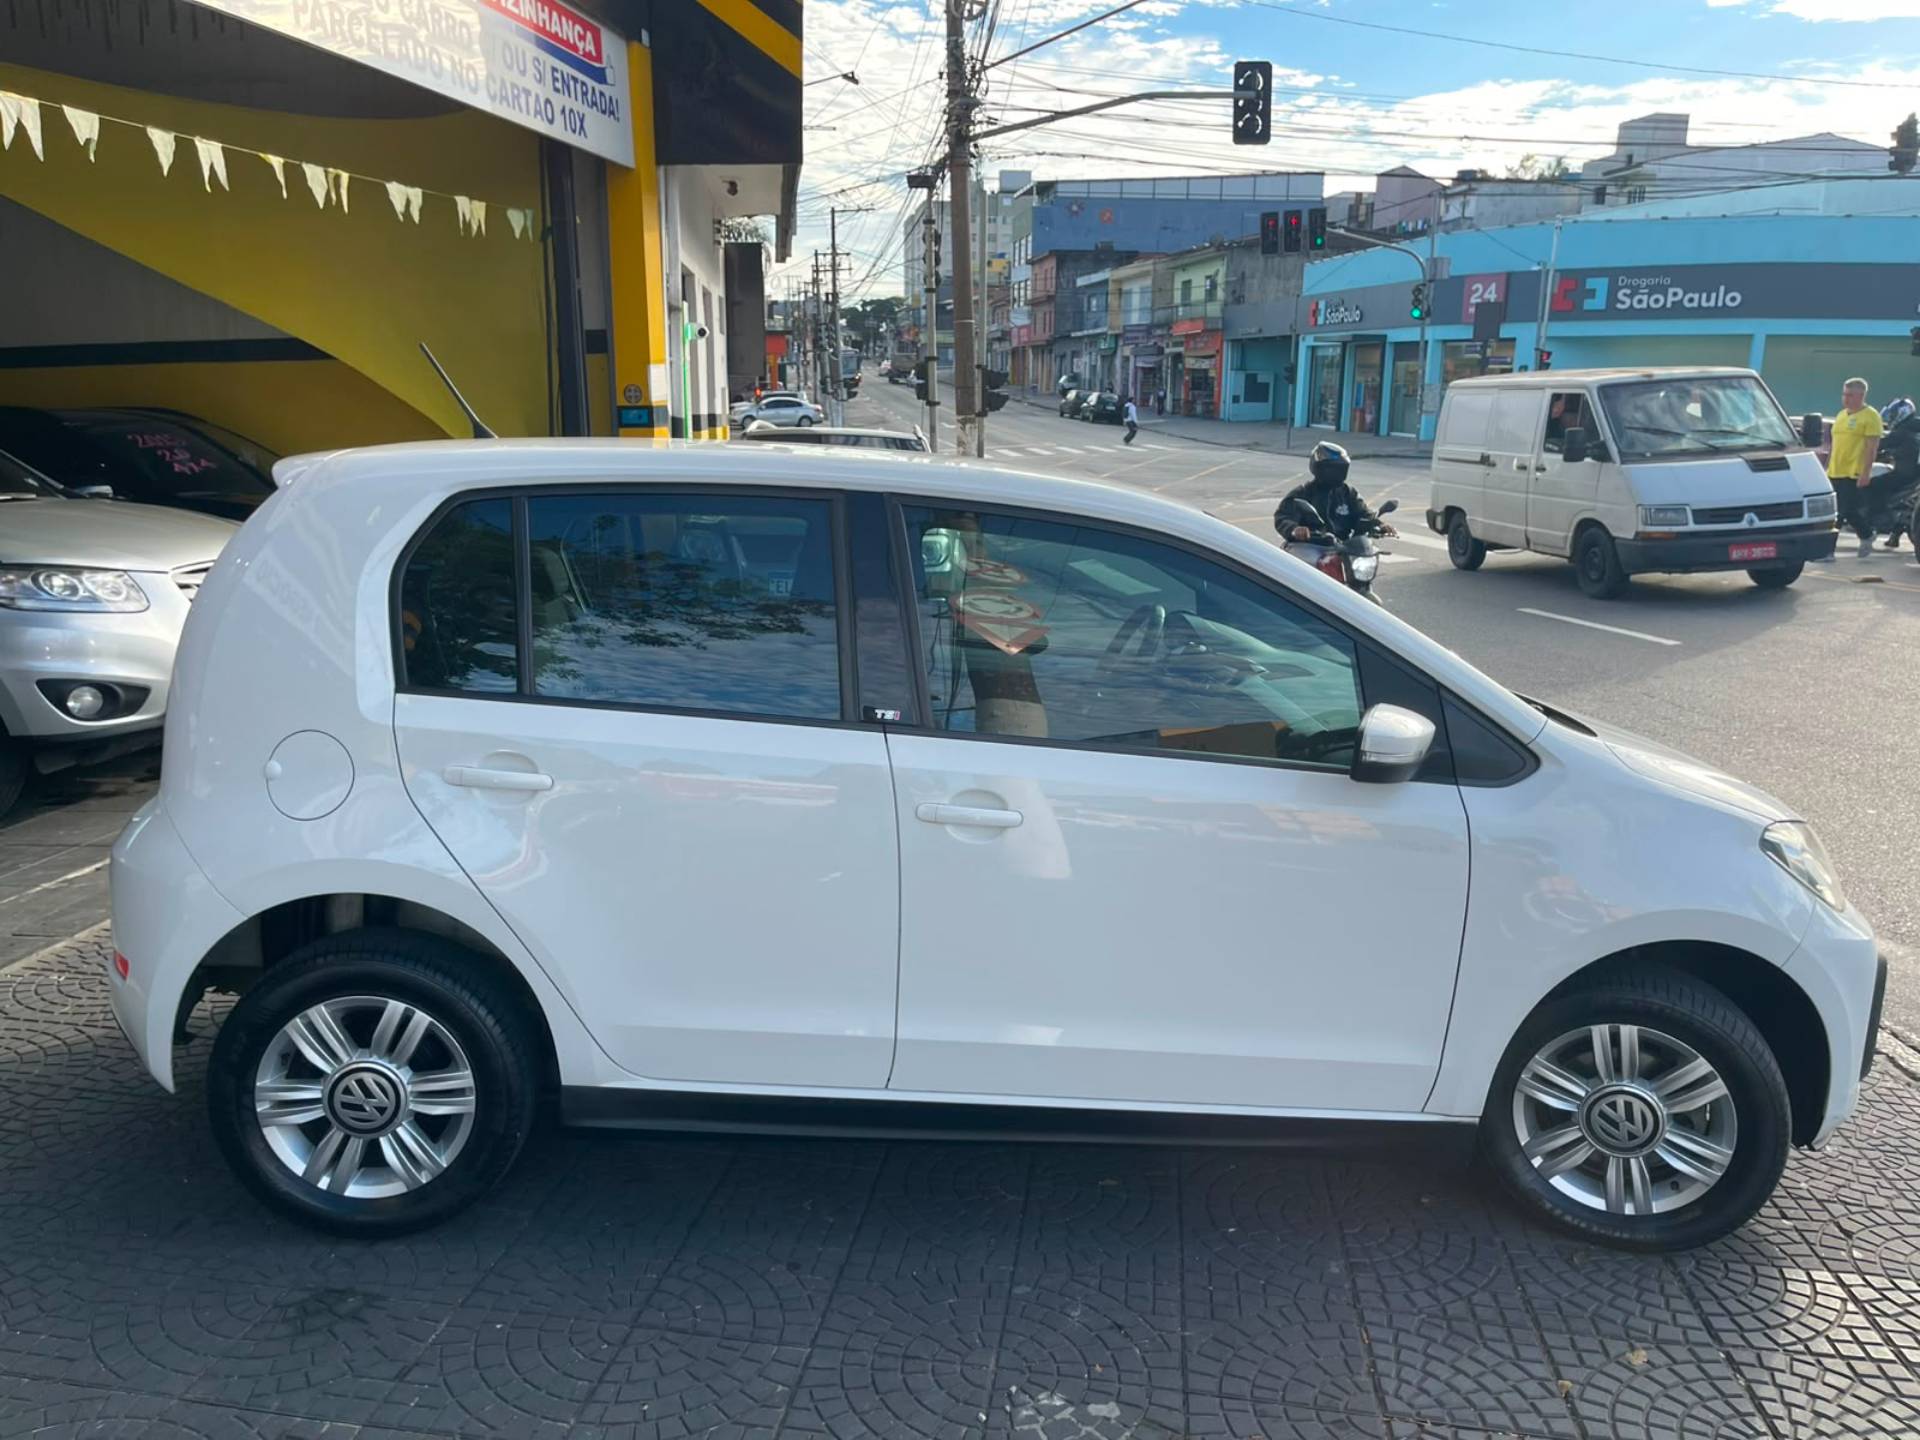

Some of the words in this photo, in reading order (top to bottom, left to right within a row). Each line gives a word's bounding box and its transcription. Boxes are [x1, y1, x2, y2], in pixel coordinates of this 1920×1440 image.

[498, 0, 596, 57] ZINHANÇA
[503, 42, 528, 78] OU
[551, 65, 620, 123] ENTRADA!
[451, 55, 480, 95] NO
[560, 104, 588, 139] 10X
[1470, 281, 1497, 304] 24
[1618, 275, 1671, 288] Drogaria
[1616, 285, 1742, 309] SãoPaulo
[875, 708, 901, 721] TSI
